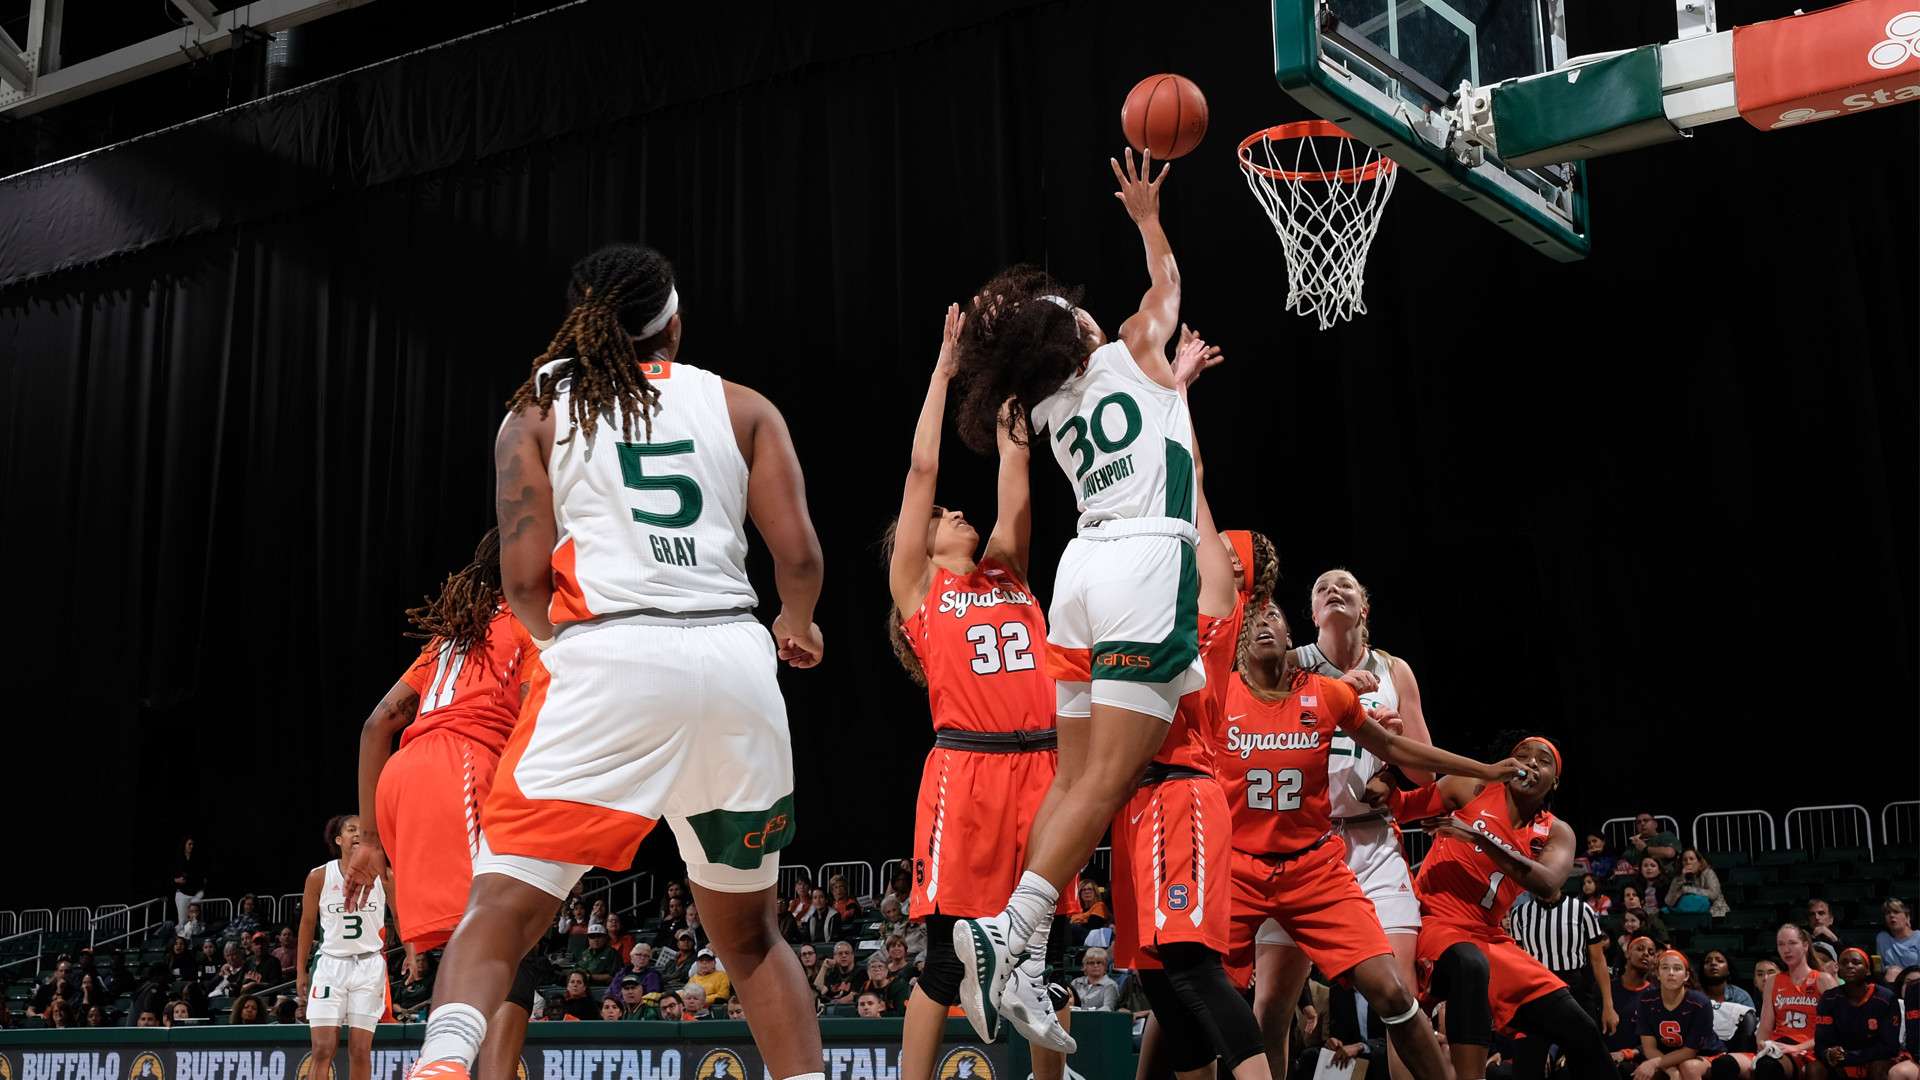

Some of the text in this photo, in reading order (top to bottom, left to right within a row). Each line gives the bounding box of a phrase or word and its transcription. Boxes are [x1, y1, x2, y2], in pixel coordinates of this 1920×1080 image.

[1056, 391, 1143, 482] 30
[615, 439, 703, 529] 5
[649, 534, 698, 567] GRAY
[938, 587, 1033, 618] Syracuse
[966, 621, 1036, 676] 32
[1227, 725, 1320, 760] Syracuse
[1246, 768, 1303, 811] 22
[1167, 884, 1188, 910] S
[1479, 870, 1506, 910] 1
[342, 915, 363, 940] 3
[1774, 993, 1818, 1010] Syracuse
[1659, 1020, 1684, 1048] S
[22, 1052, 121, 1080] BUFFALO
[175, 1050, 286, 1080] BUFFALO
[541, 1049, 682, 1080] BUFFALO
